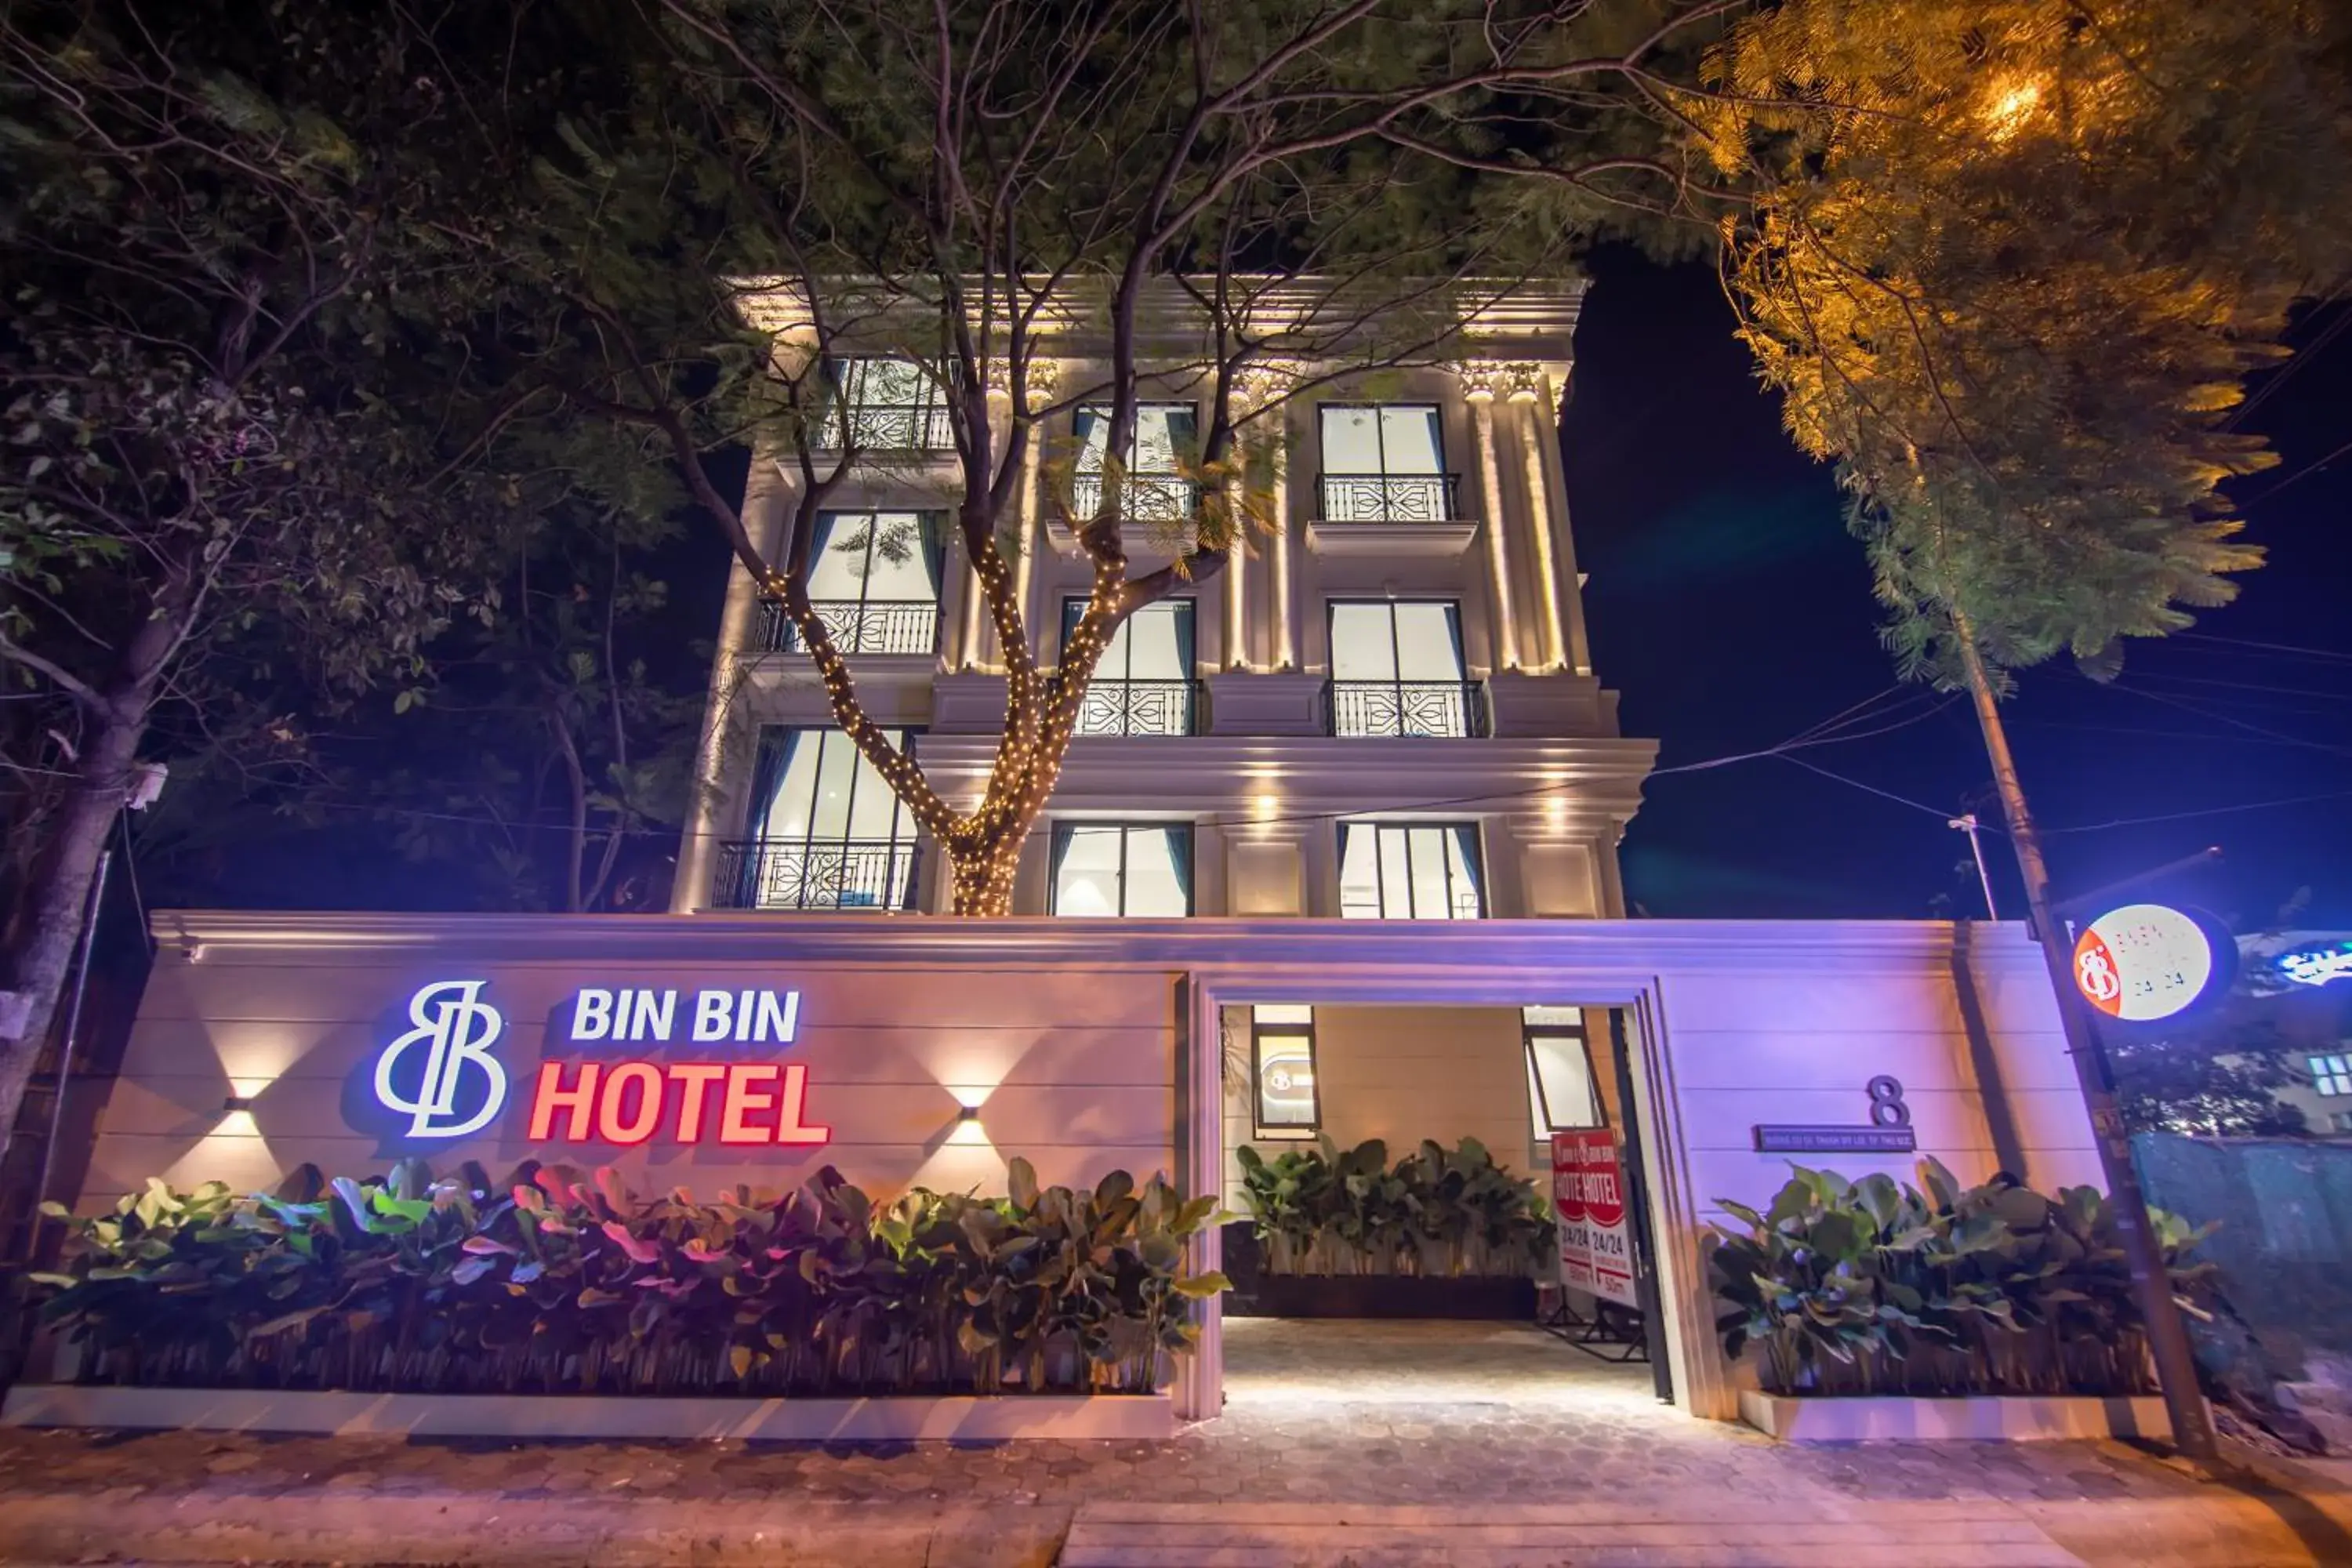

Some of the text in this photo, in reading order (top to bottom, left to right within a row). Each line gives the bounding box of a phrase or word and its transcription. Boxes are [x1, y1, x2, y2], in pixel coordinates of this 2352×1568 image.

[570, 989, 800, 1043] BIN BIN
[528, 1061, 831, 1145] HOTEL
[1867, 1075, 1911, 1127] 8
[1555, 1172, 1583, 1202] HOTE
[1582, 1172, 1621, 1206] HOTEL
[1592, 1230, 1624, 1256] 24/24
